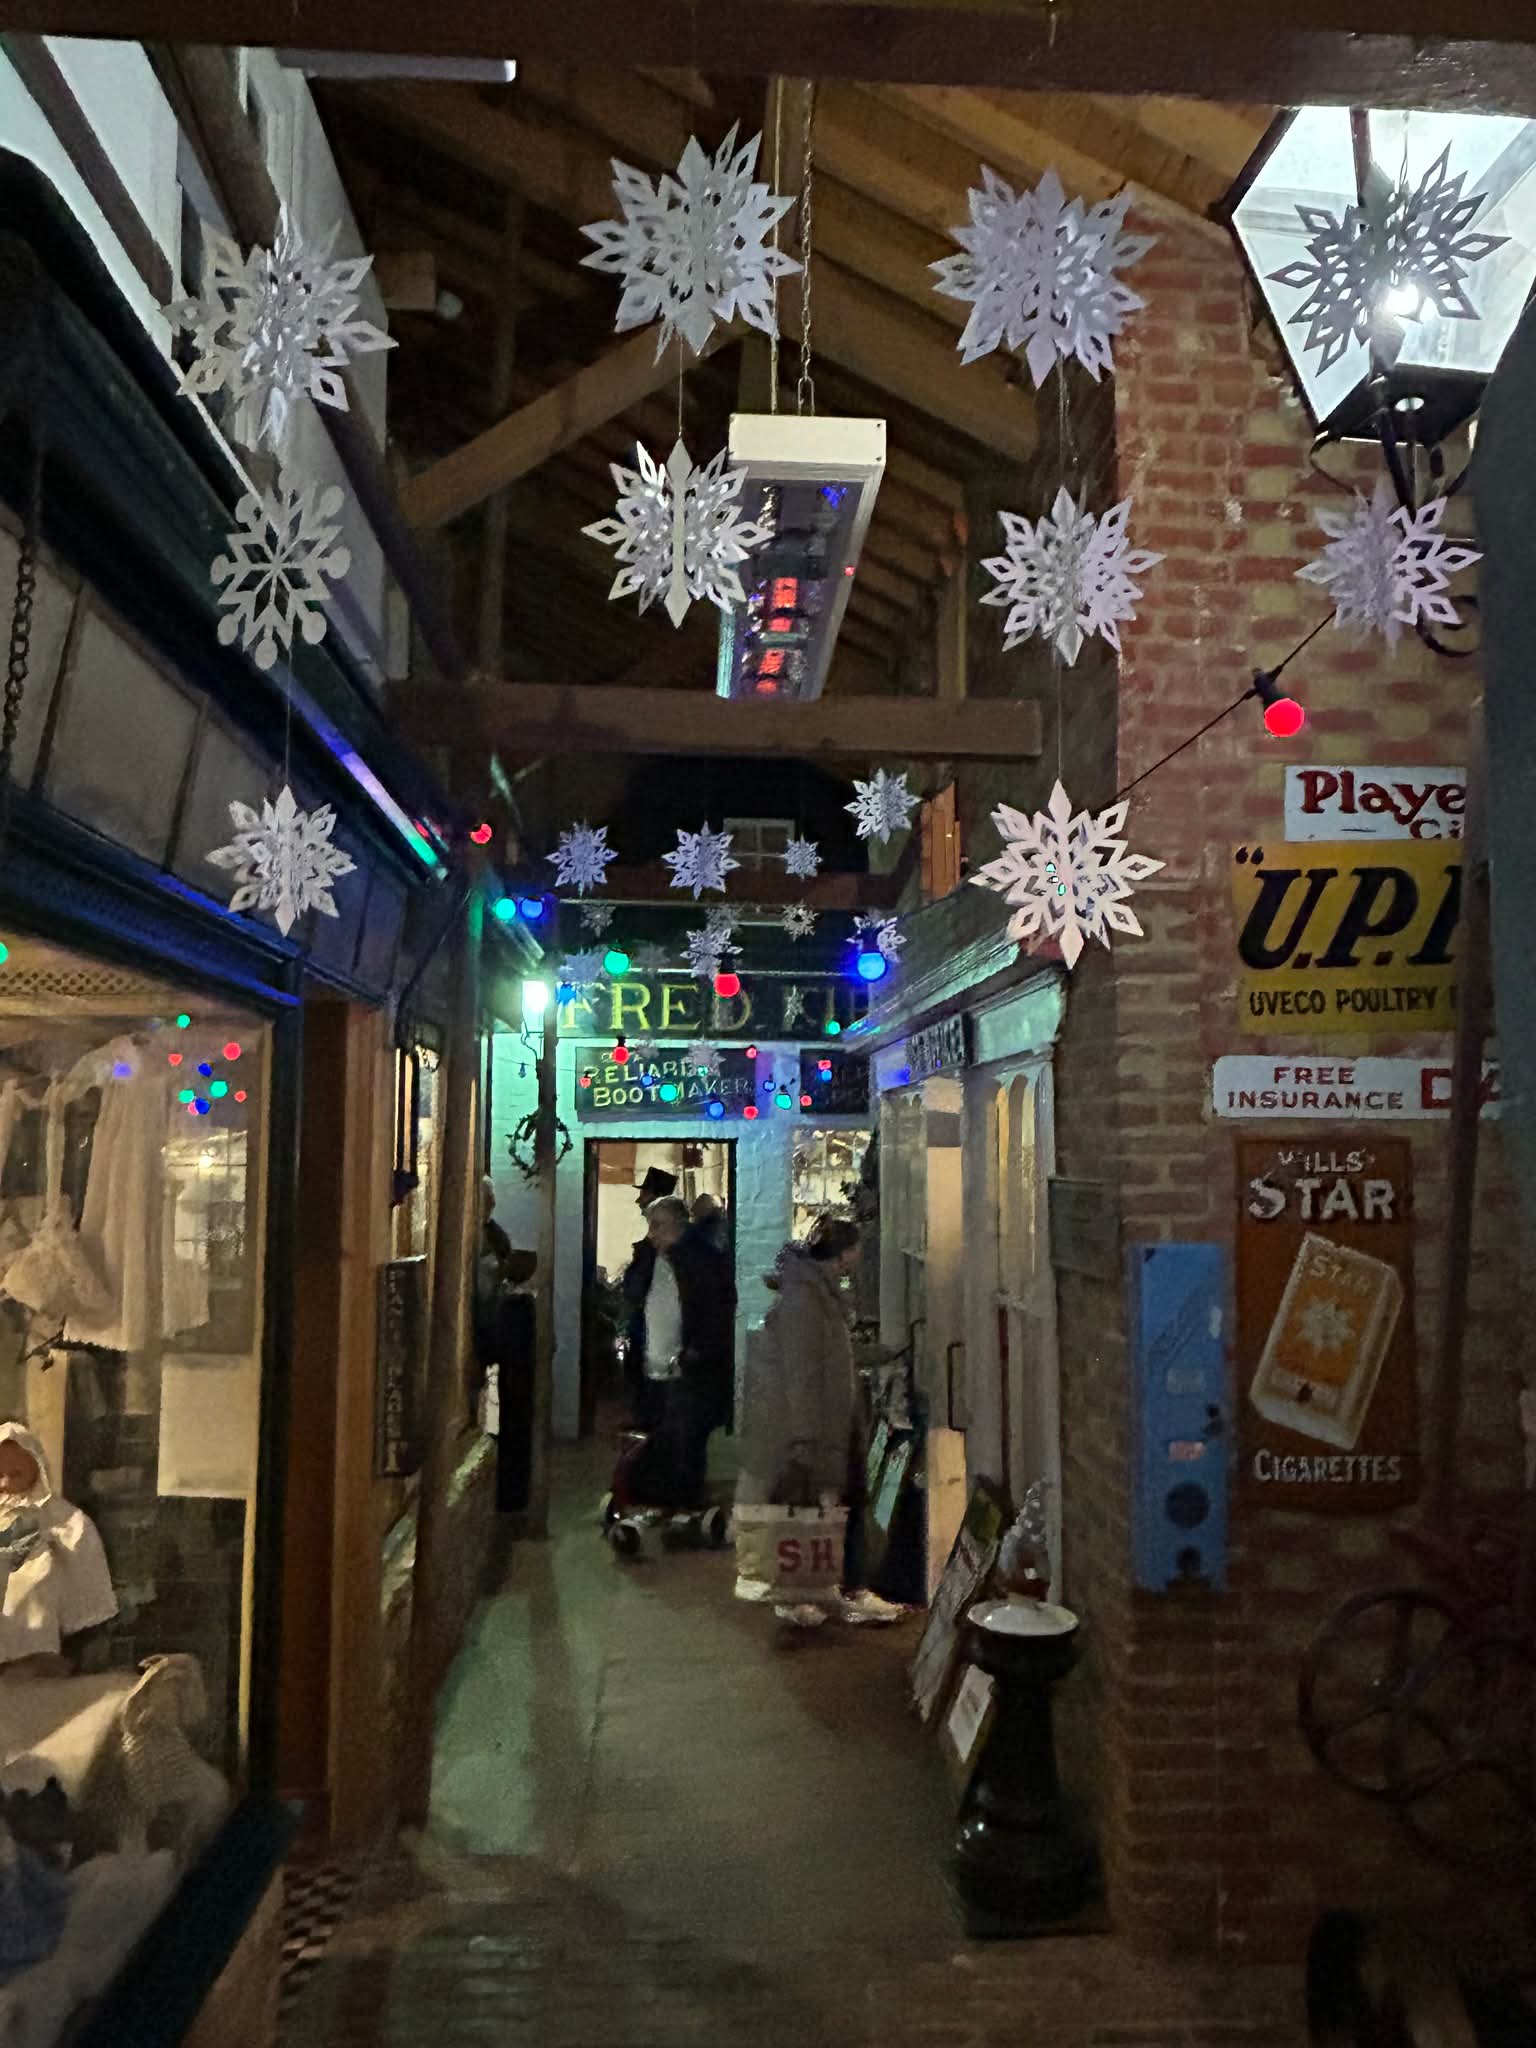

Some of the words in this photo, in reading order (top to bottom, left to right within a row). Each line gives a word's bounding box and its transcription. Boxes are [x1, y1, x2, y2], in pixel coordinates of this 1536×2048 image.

[1249, 990, 1326, 1016] UVECO
[1336, 986, 1438, 1014] POULTRY
[1273, 1066, 1356, 1085] FREE
[1227, 1090, 1403, 1111] INSURANCE
[1248, 1177, 1395, 1220] STAR
[1254, 1449, 1402, 1482] CIGARETTES
